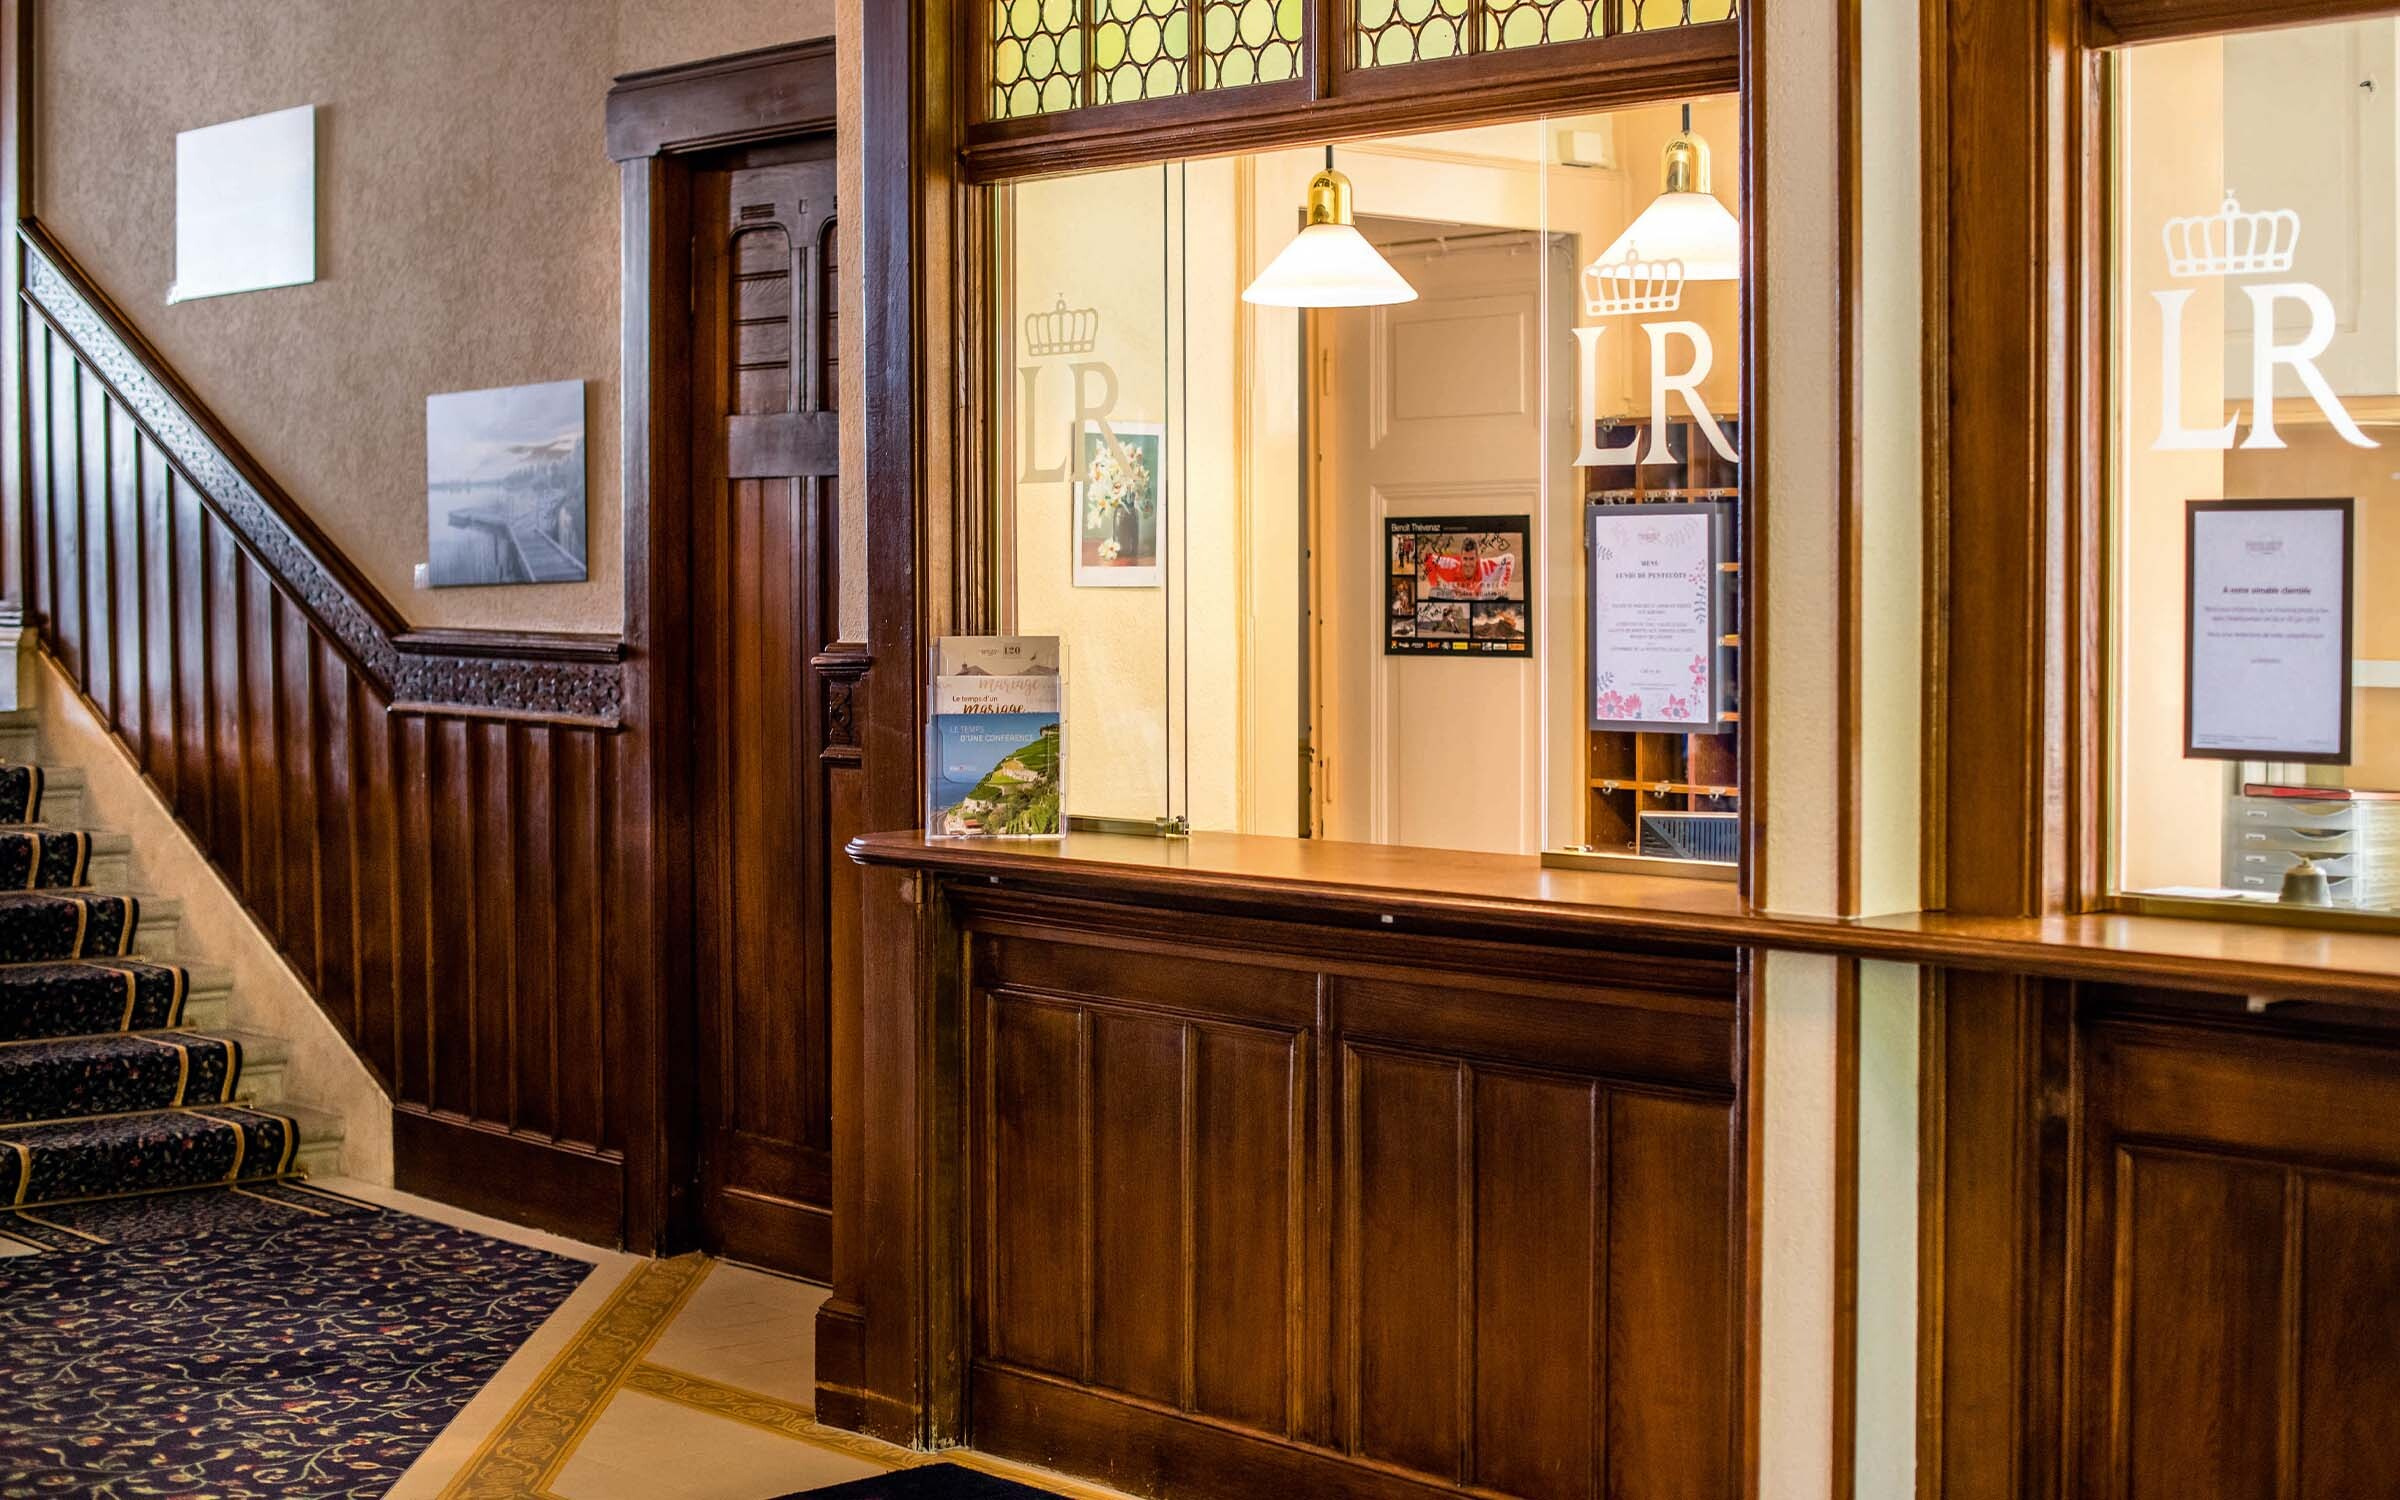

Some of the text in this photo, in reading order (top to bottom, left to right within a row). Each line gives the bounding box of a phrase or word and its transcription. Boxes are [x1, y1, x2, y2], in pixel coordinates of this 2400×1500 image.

[1018, 361, 1141, 484] LR
[1571, 320, 1740, 466] LR
[2150, 282, 2382, 449] LR
[962, 695, 982, 704] temps
[1003, 646, 1021, 655] 120
